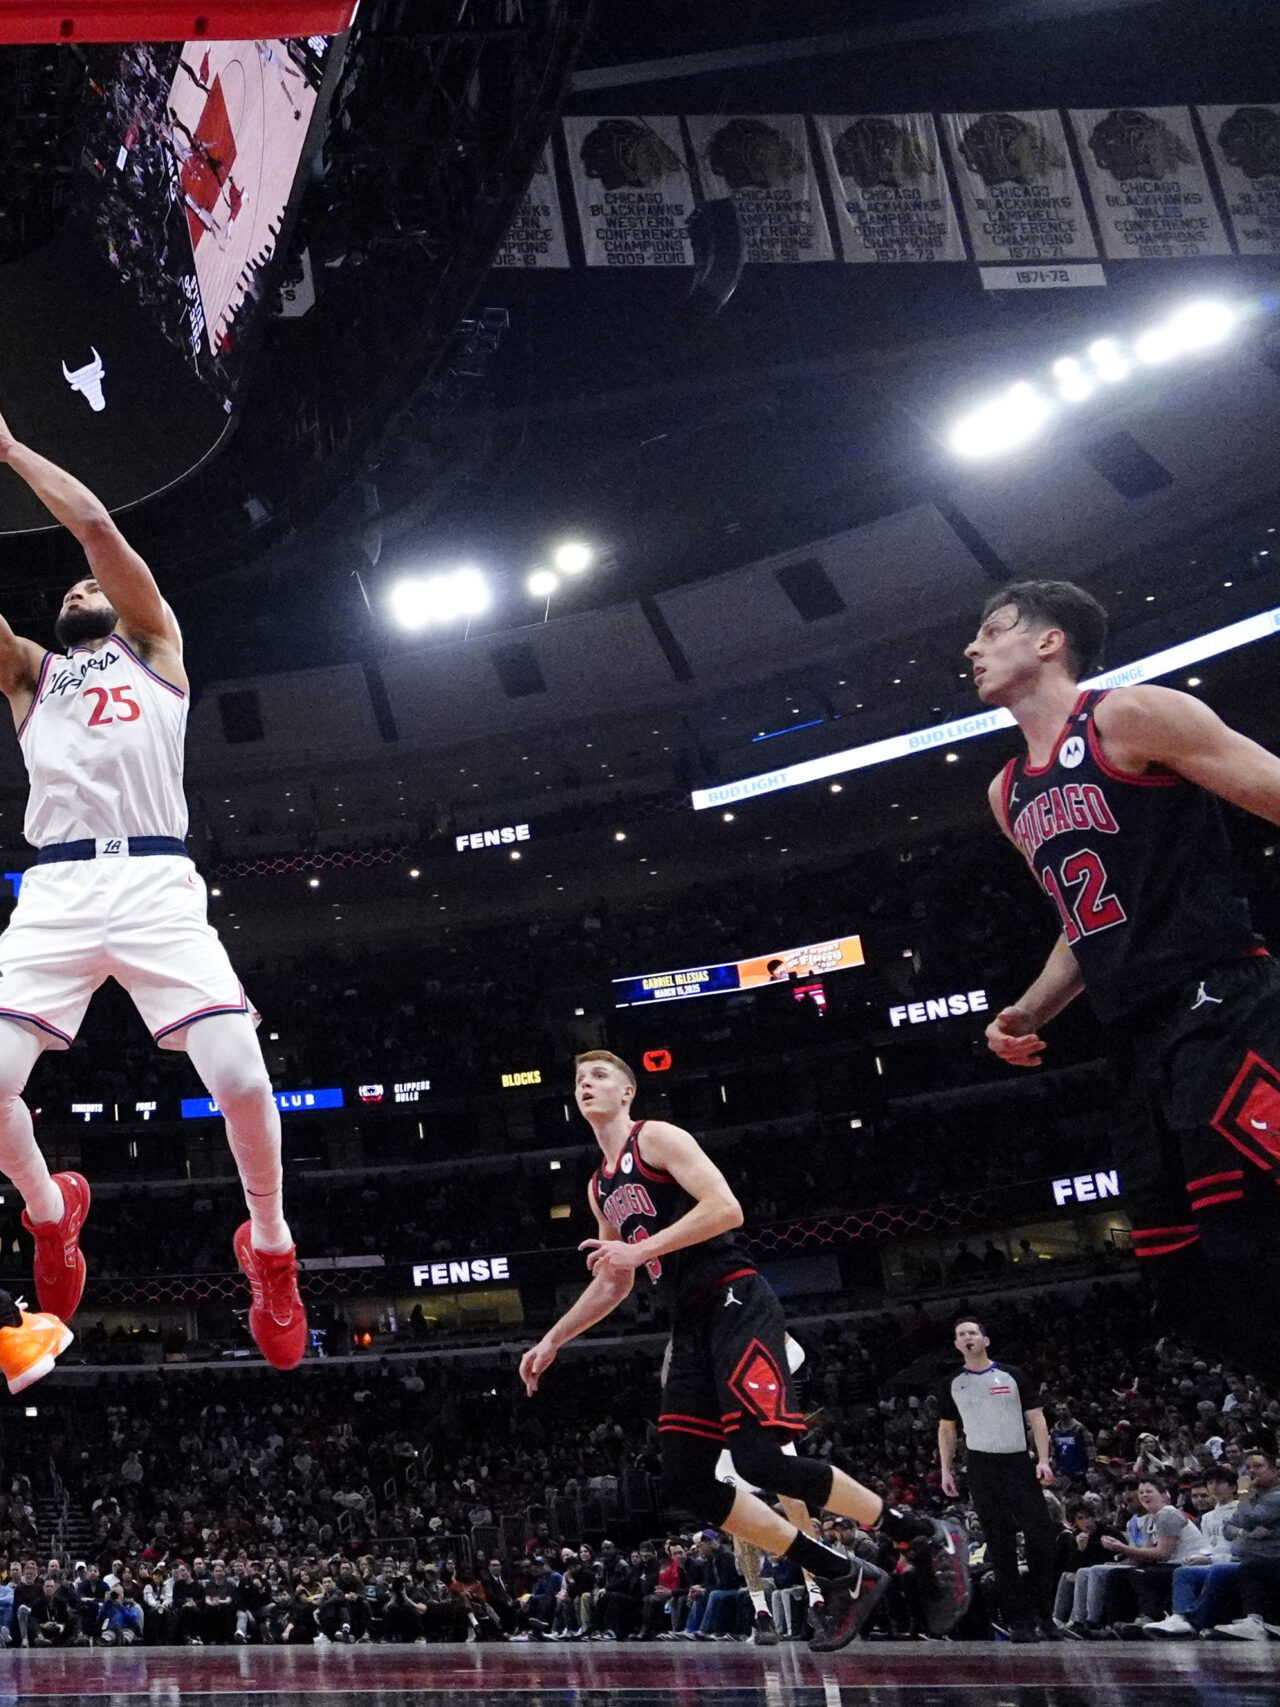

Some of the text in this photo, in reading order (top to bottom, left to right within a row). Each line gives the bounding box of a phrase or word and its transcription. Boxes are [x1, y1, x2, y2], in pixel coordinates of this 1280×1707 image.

[605, 193, 663, 204] CHICAGO
[591, 204, 684, 216] BLACKHAWKS
[604, 241, 684, 252] CHAMPIONS
[83, 685, 140, 727] 25
[908, 714, 999, 750] BUD LIGHT
[708, 772, 789, 804] BUD LIGHT
[102, 839, 121, 854] LA
[456, 823, 531, 852] FENSE
[1042, 848, 1127, 946] 12
[642, 970, 709, 990] GABRIEL IGLESIAS
[889, 989, 989, 1027] FENSE
[394, 1080, 430, 1094] CLIPPERS
[502, 1070, 541, 1088] BLOCKS
[395, 1092, 419, 1102] BULLS
[412, 1257, 510, 1287] FENSE
